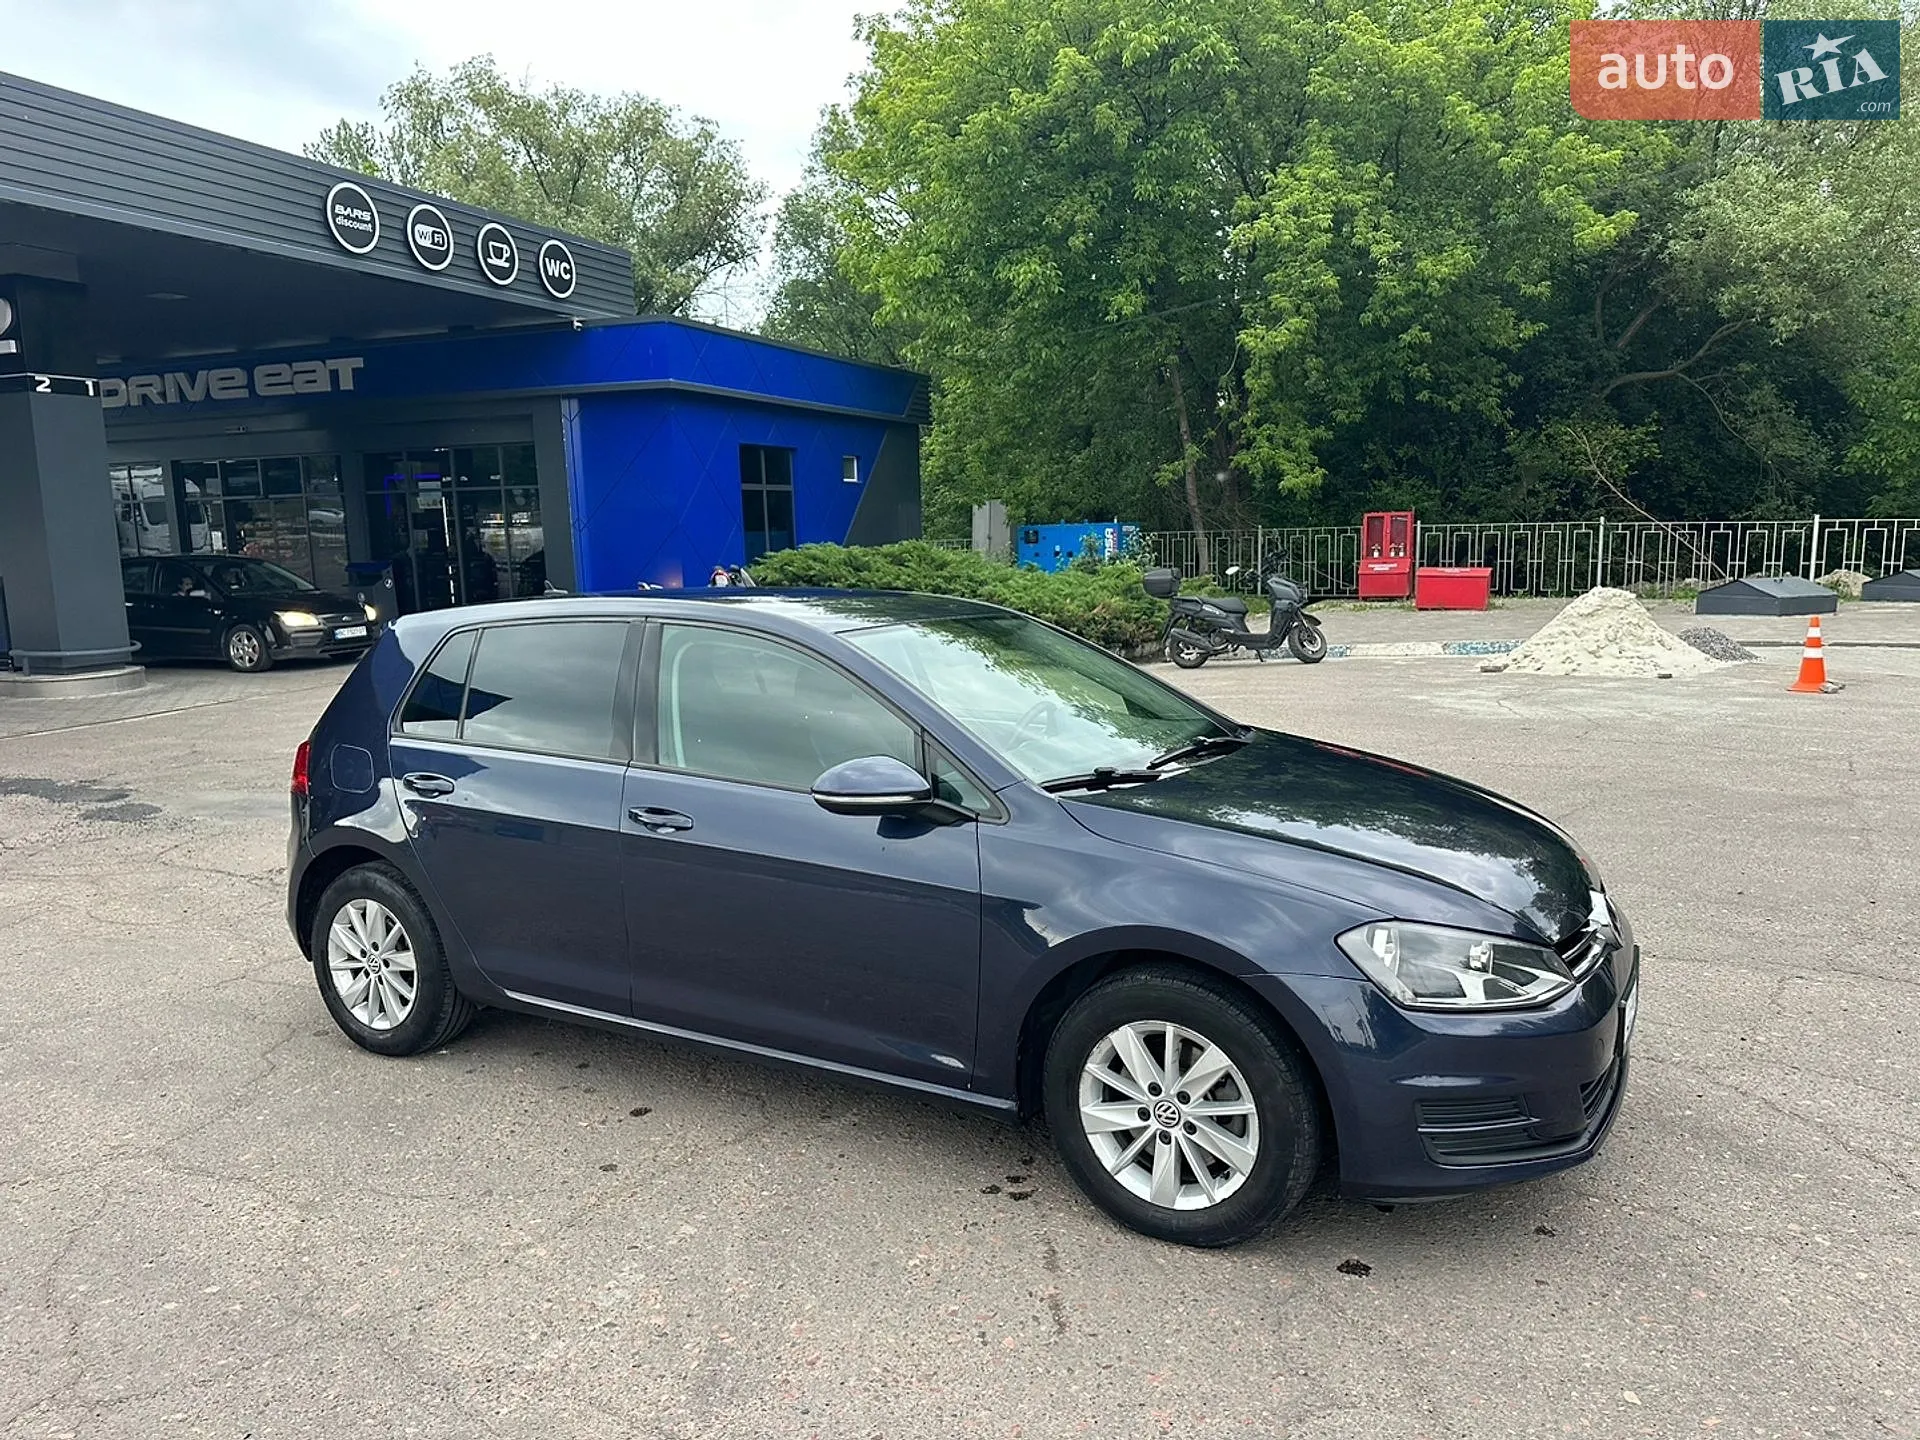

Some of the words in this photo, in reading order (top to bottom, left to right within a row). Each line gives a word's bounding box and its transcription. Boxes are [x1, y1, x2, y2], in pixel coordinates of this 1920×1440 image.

[334, 204, 372, 221] BARS
[336, 216, 373, 232] discount
[545, 257, 571, 280] WC
[34, 375, 52, 393] 2
[85, 380, 95, 396] 1
